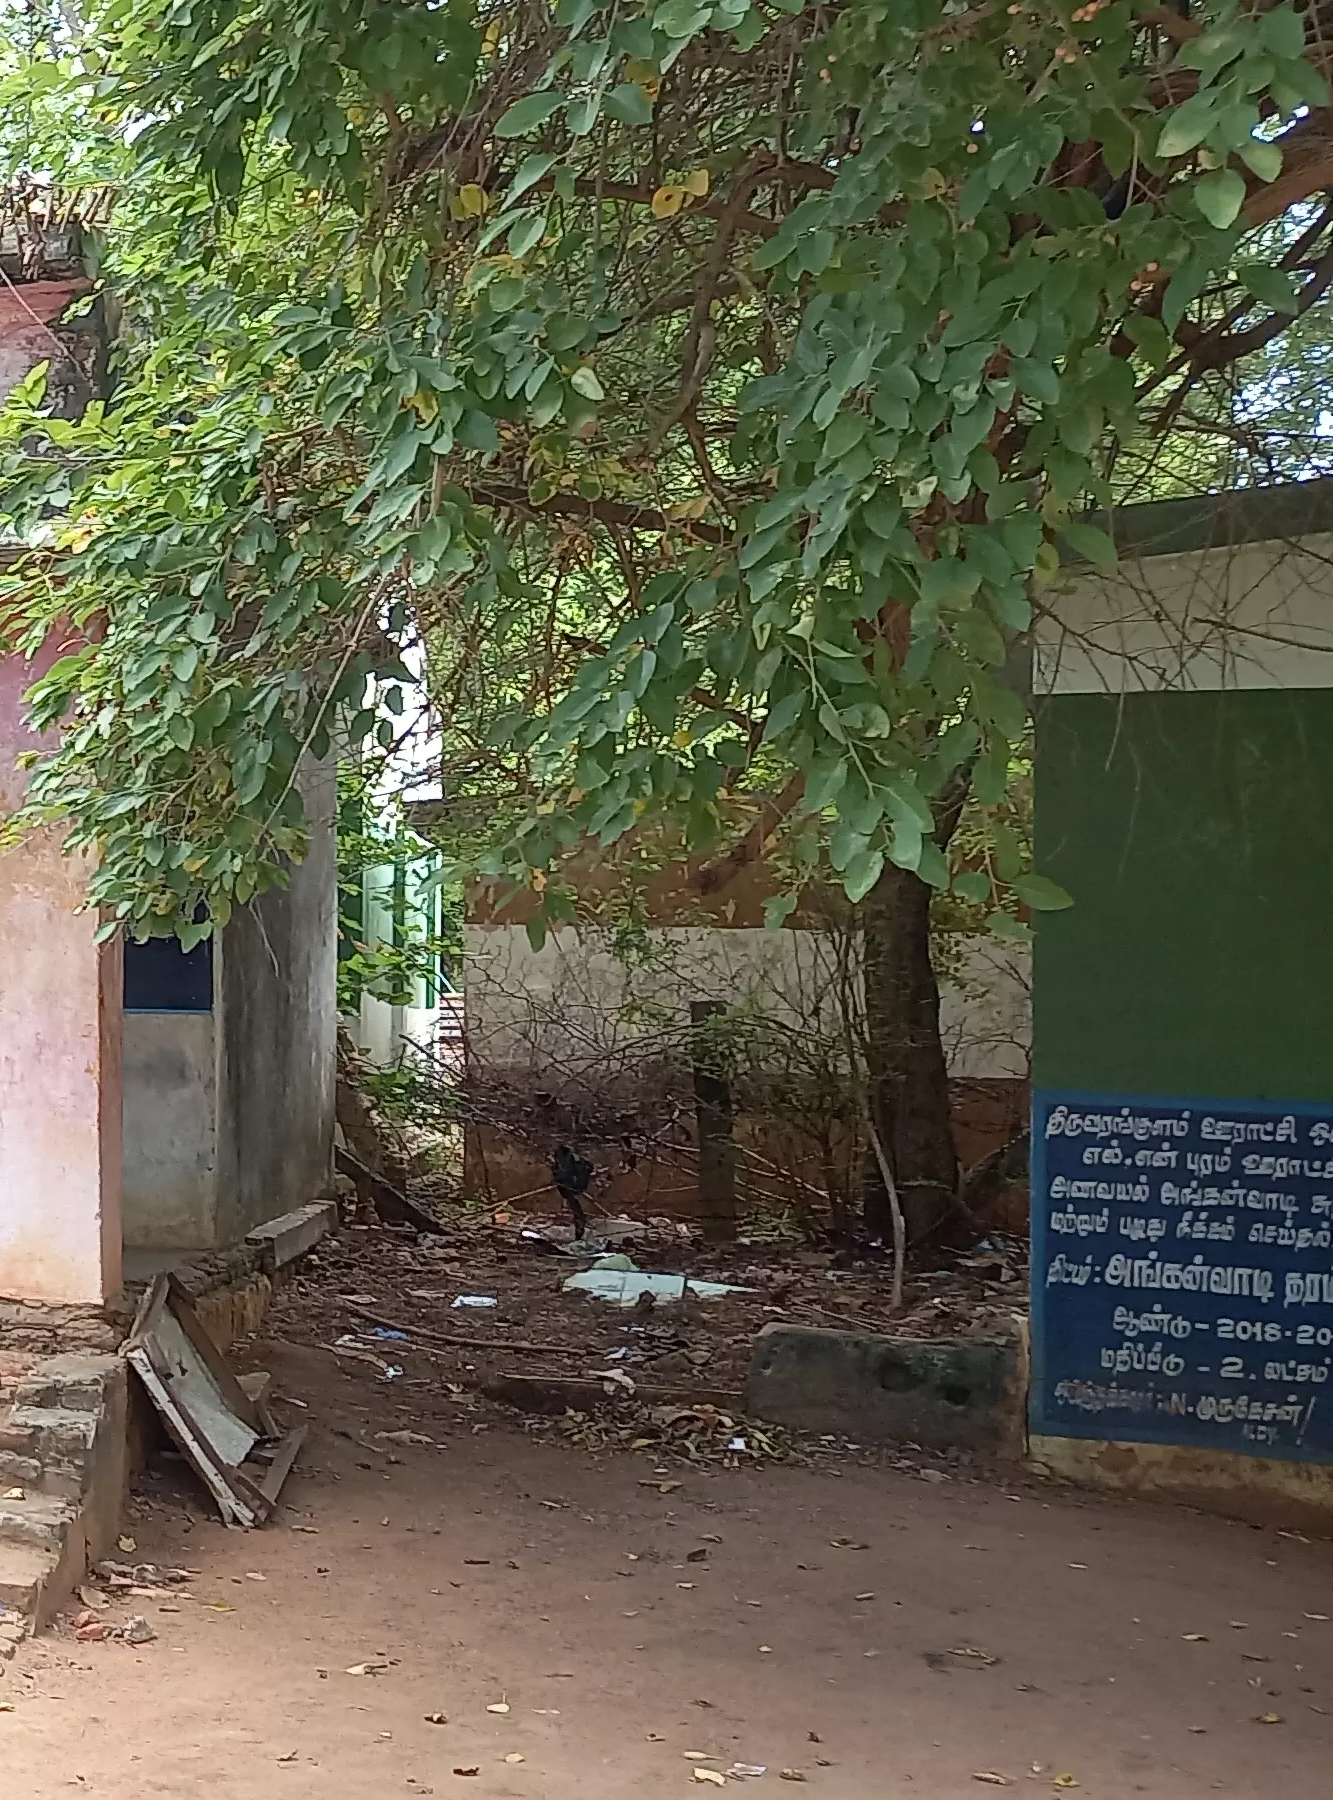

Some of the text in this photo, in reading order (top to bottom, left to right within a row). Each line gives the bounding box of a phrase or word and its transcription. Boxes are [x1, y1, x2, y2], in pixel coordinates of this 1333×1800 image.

[1045, 1105, 1191, 1141] திருவரங்குளம்
[1200, 1115, 1298, 1147] ஊராட்சி
[1160, 1178, 1299, 1215] அங்கன்வாடி
[1104, 1250, 1276, 1303] அங்கன்வாடி
[1112, 1302, 1192, 1339] ஆண்டு
